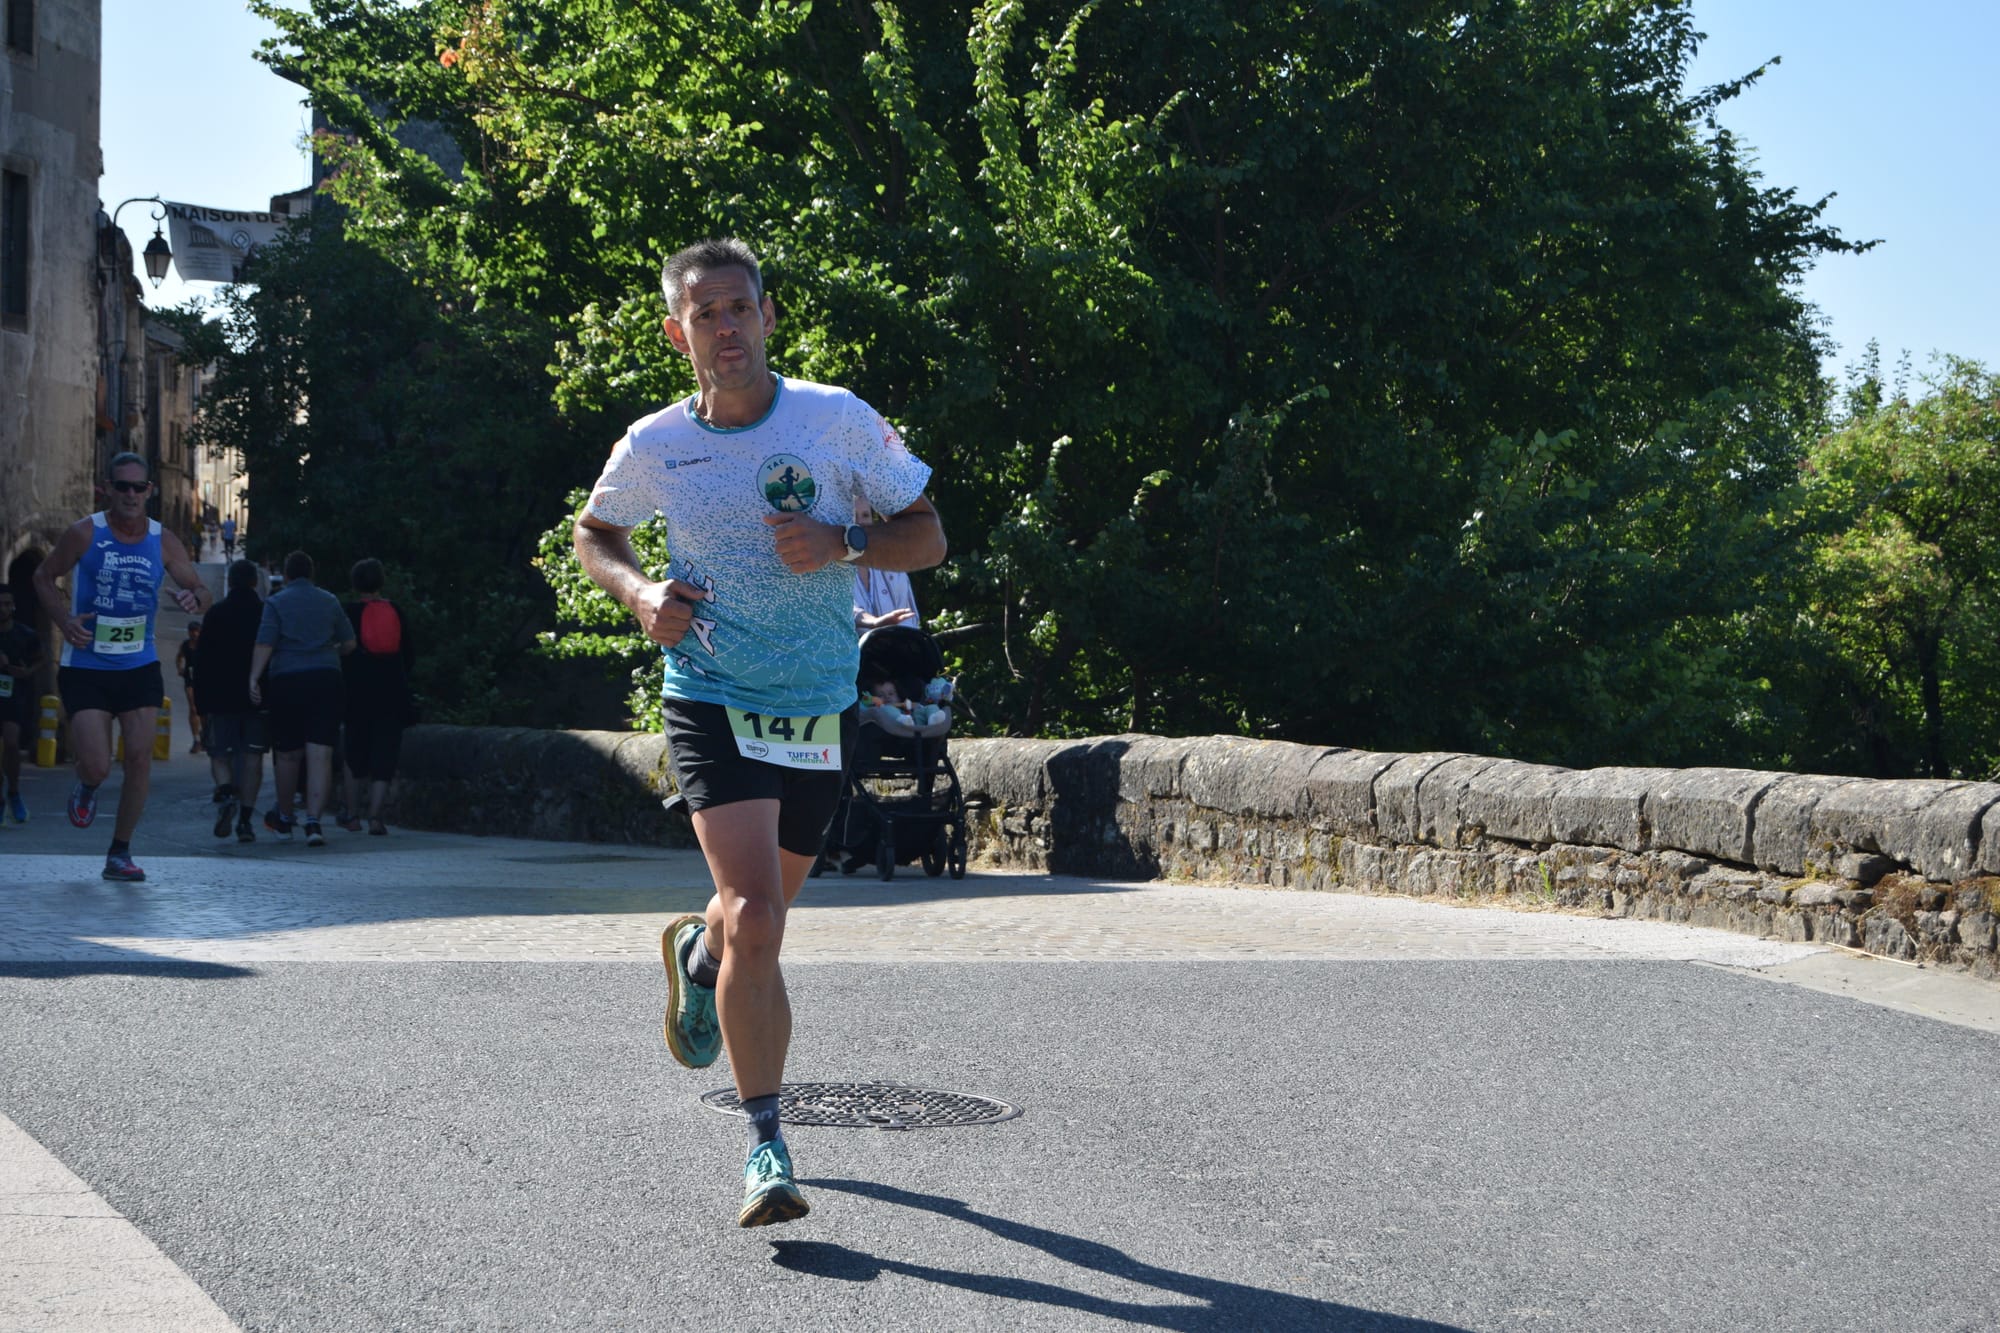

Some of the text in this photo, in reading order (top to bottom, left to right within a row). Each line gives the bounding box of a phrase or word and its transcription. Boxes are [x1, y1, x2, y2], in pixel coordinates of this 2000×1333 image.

[172, 207, 249, 222] MAISON
[767, 458, 785, 471] TAC
[110, 626, 135, 643] 25
[743, 712, 821, 741] 147
